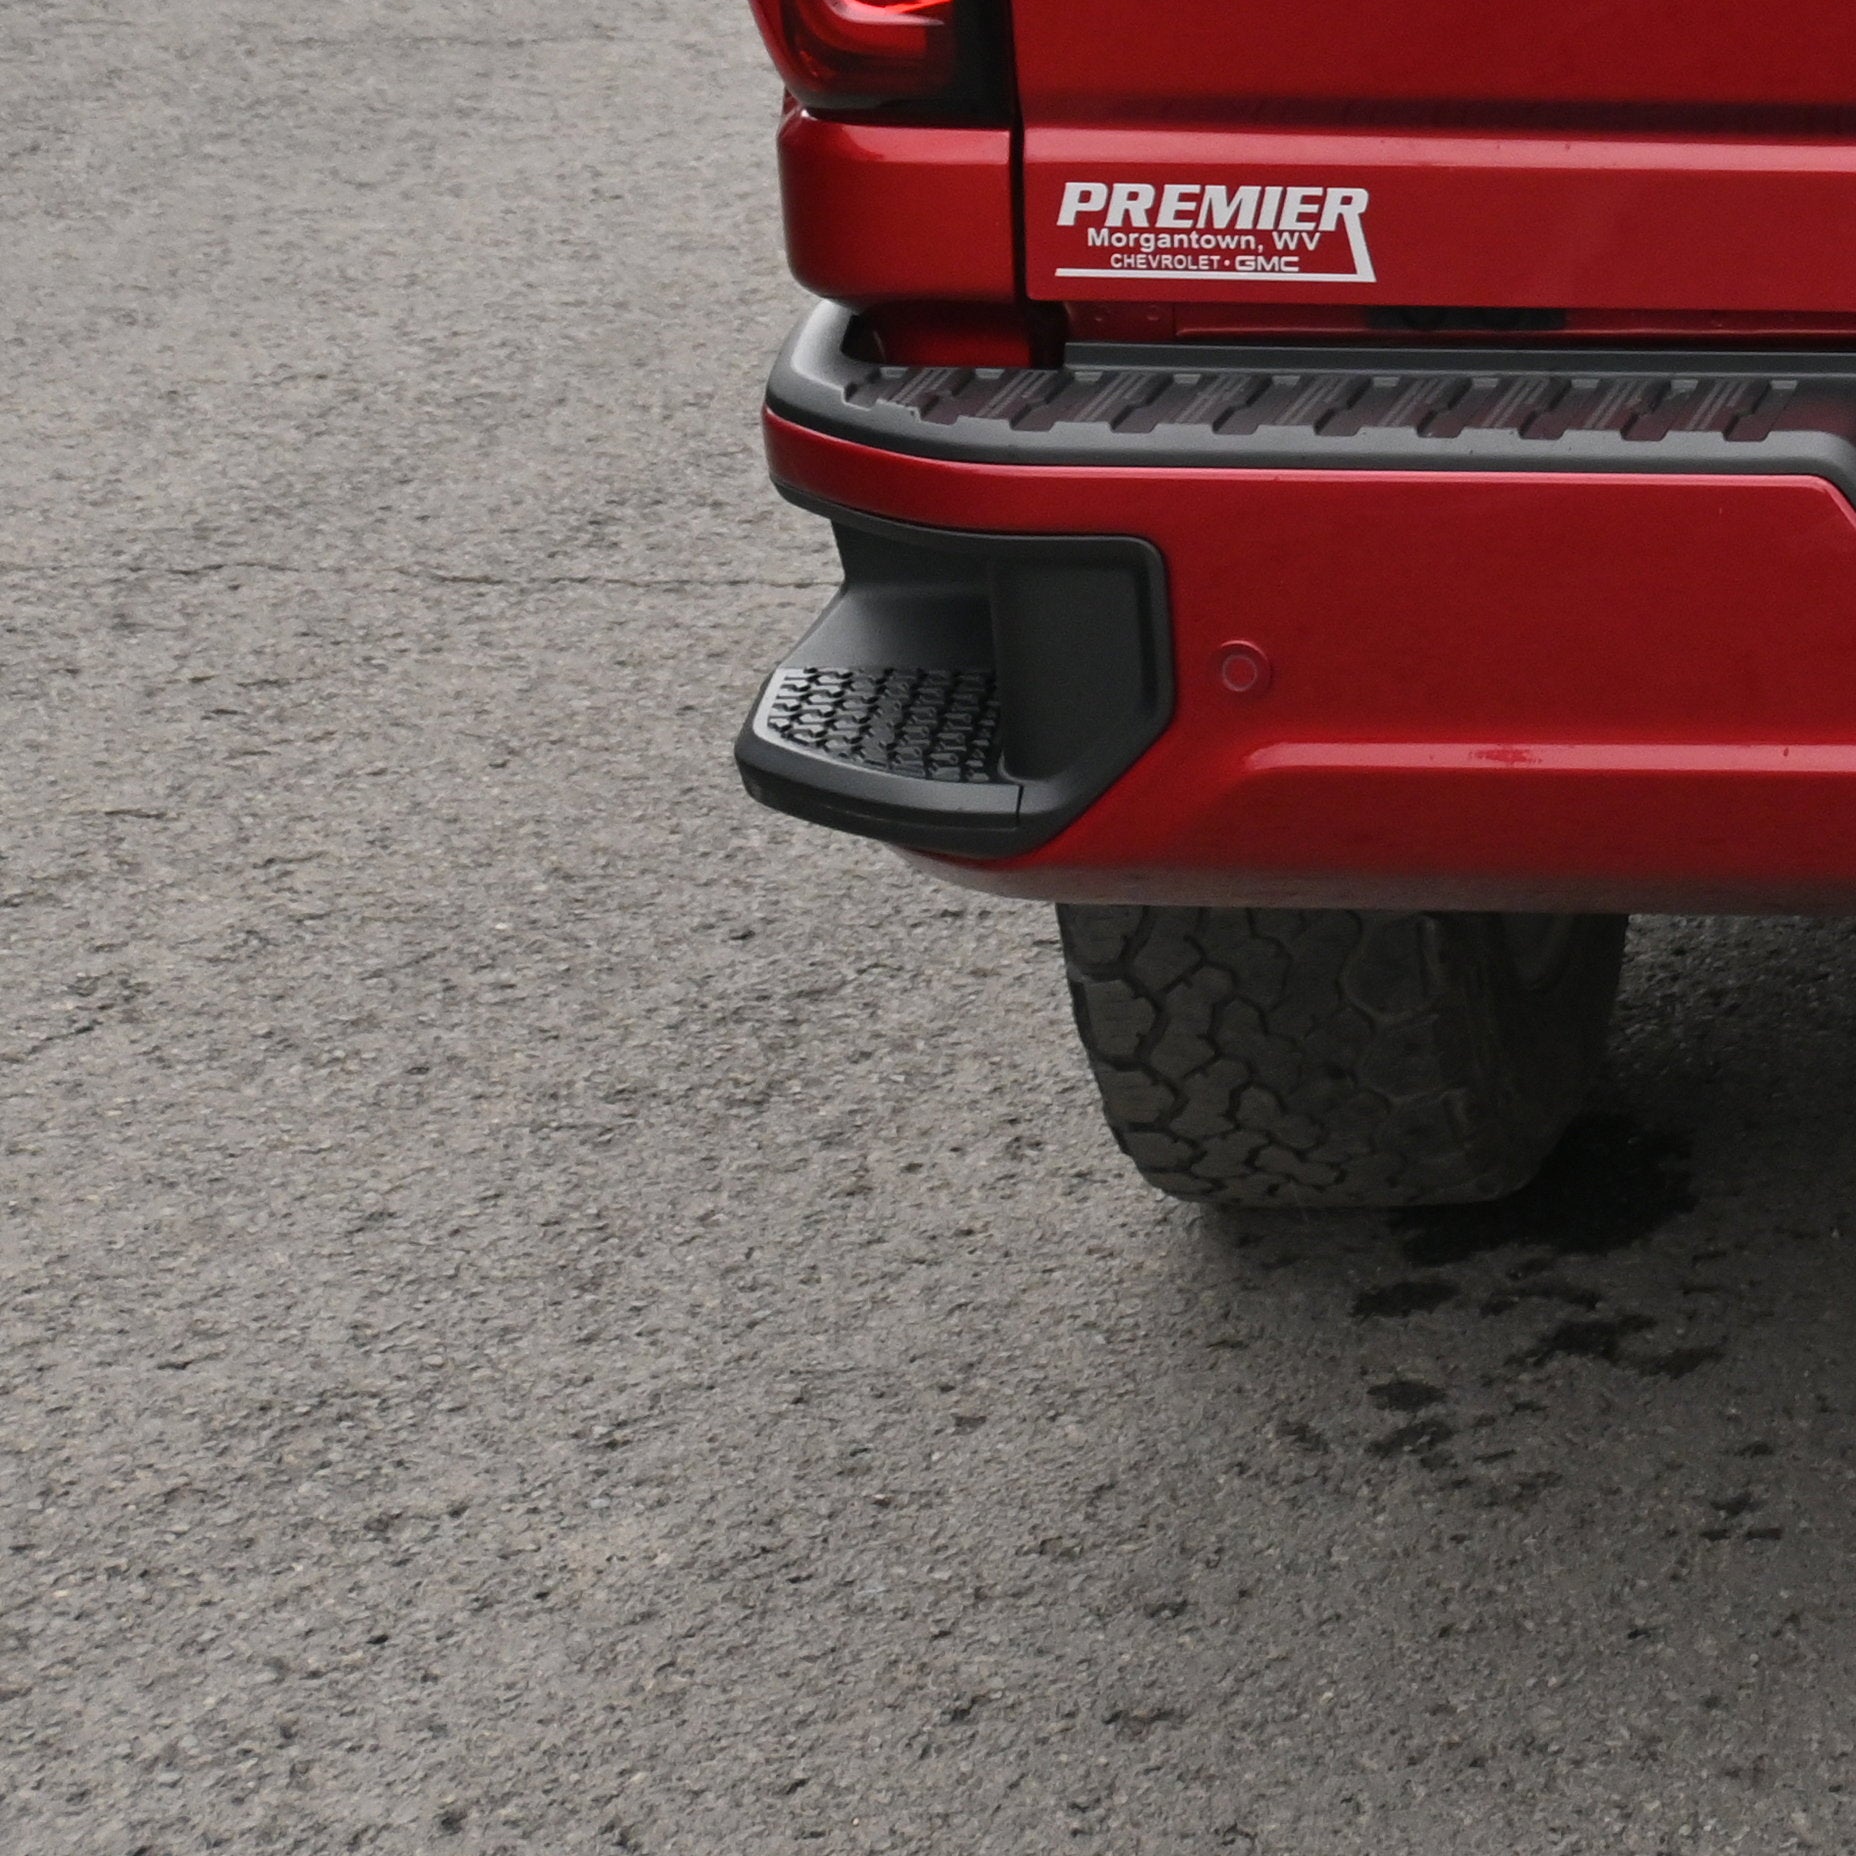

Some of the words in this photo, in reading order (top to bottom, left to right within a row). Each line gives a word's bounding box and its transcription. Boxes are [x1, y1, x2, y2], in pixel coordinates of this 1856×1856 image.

[1087, 227, 1264, 253] Morgantown,
[1272, 231, 1321, 251] WV
[1110, 253, 1221, 270] CHEVROLET
[1235, 255, 1300, 272] GMC
